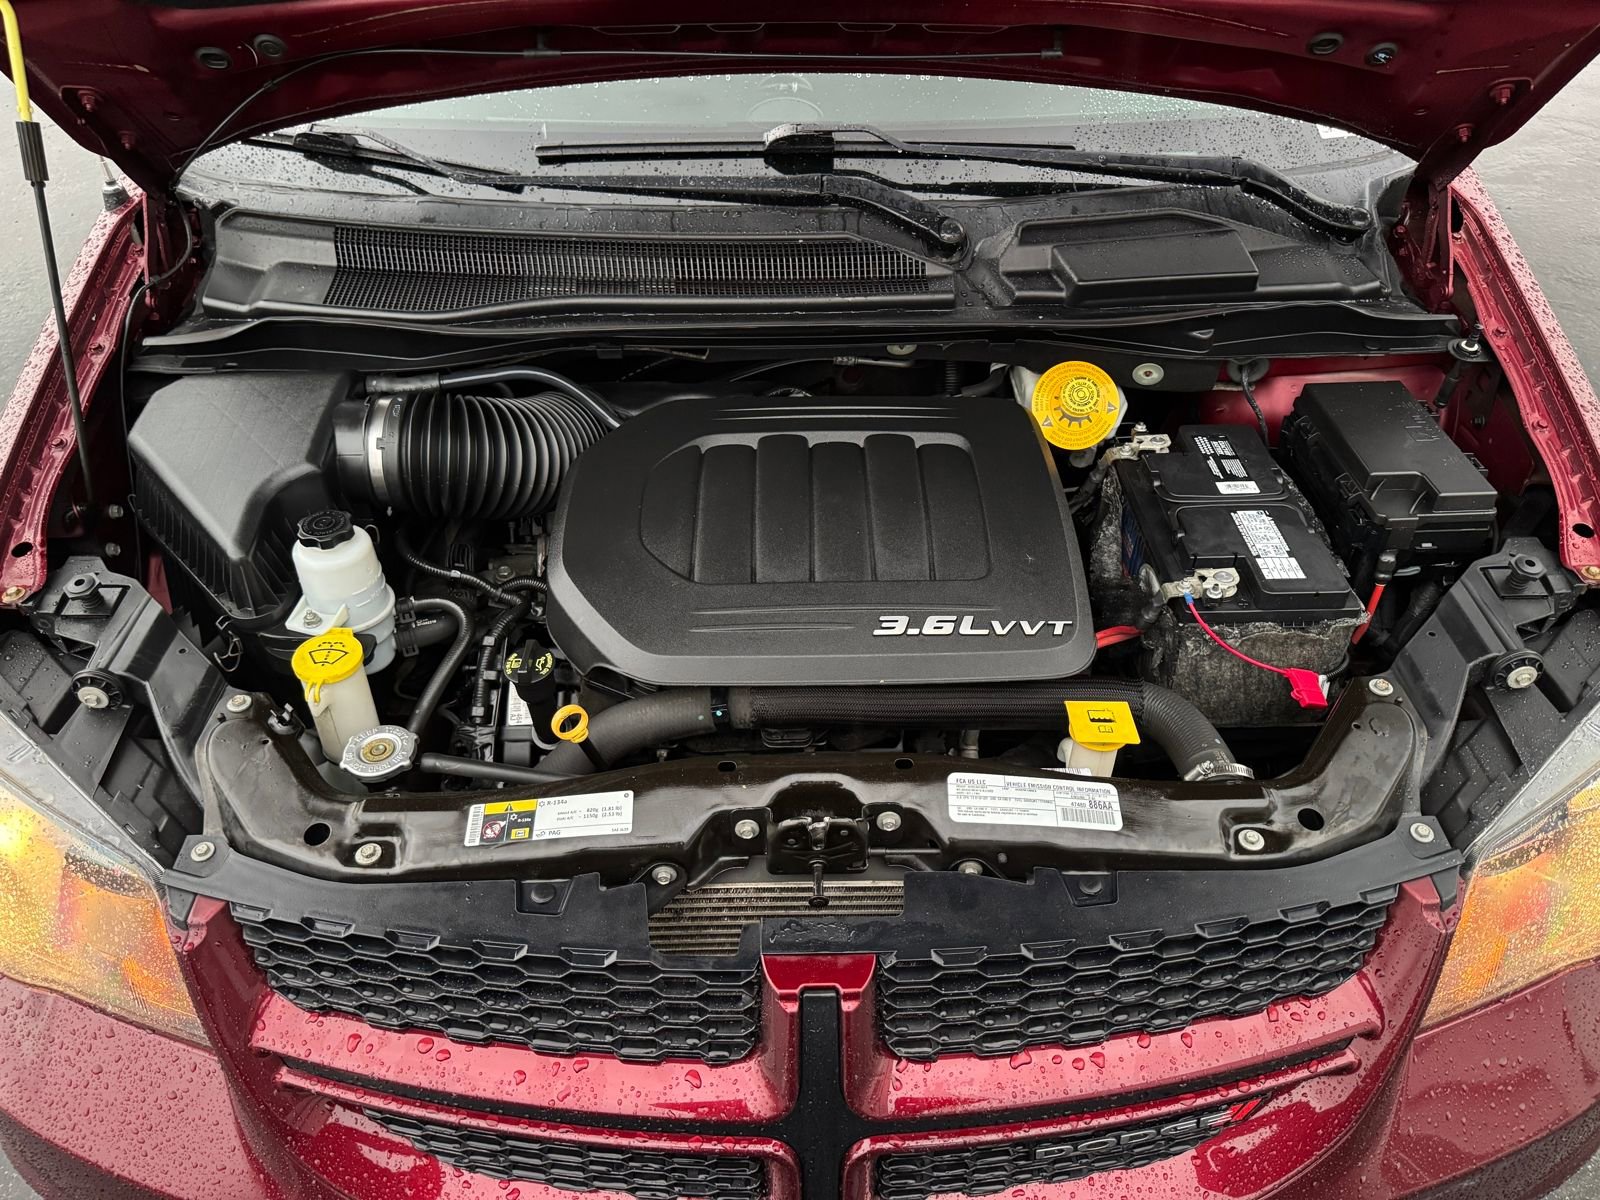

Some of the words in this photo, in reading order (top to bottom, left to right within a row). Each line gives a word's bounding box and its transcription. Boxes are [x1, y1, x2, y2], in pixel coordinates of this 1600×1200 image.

[873, 615, 990, 636] 3.6L
[990, 620, 1073, 636] VVT
[1088, 800, 1113, 810] 886AA
[1035, 1110, 1232, 1160] DODGE
